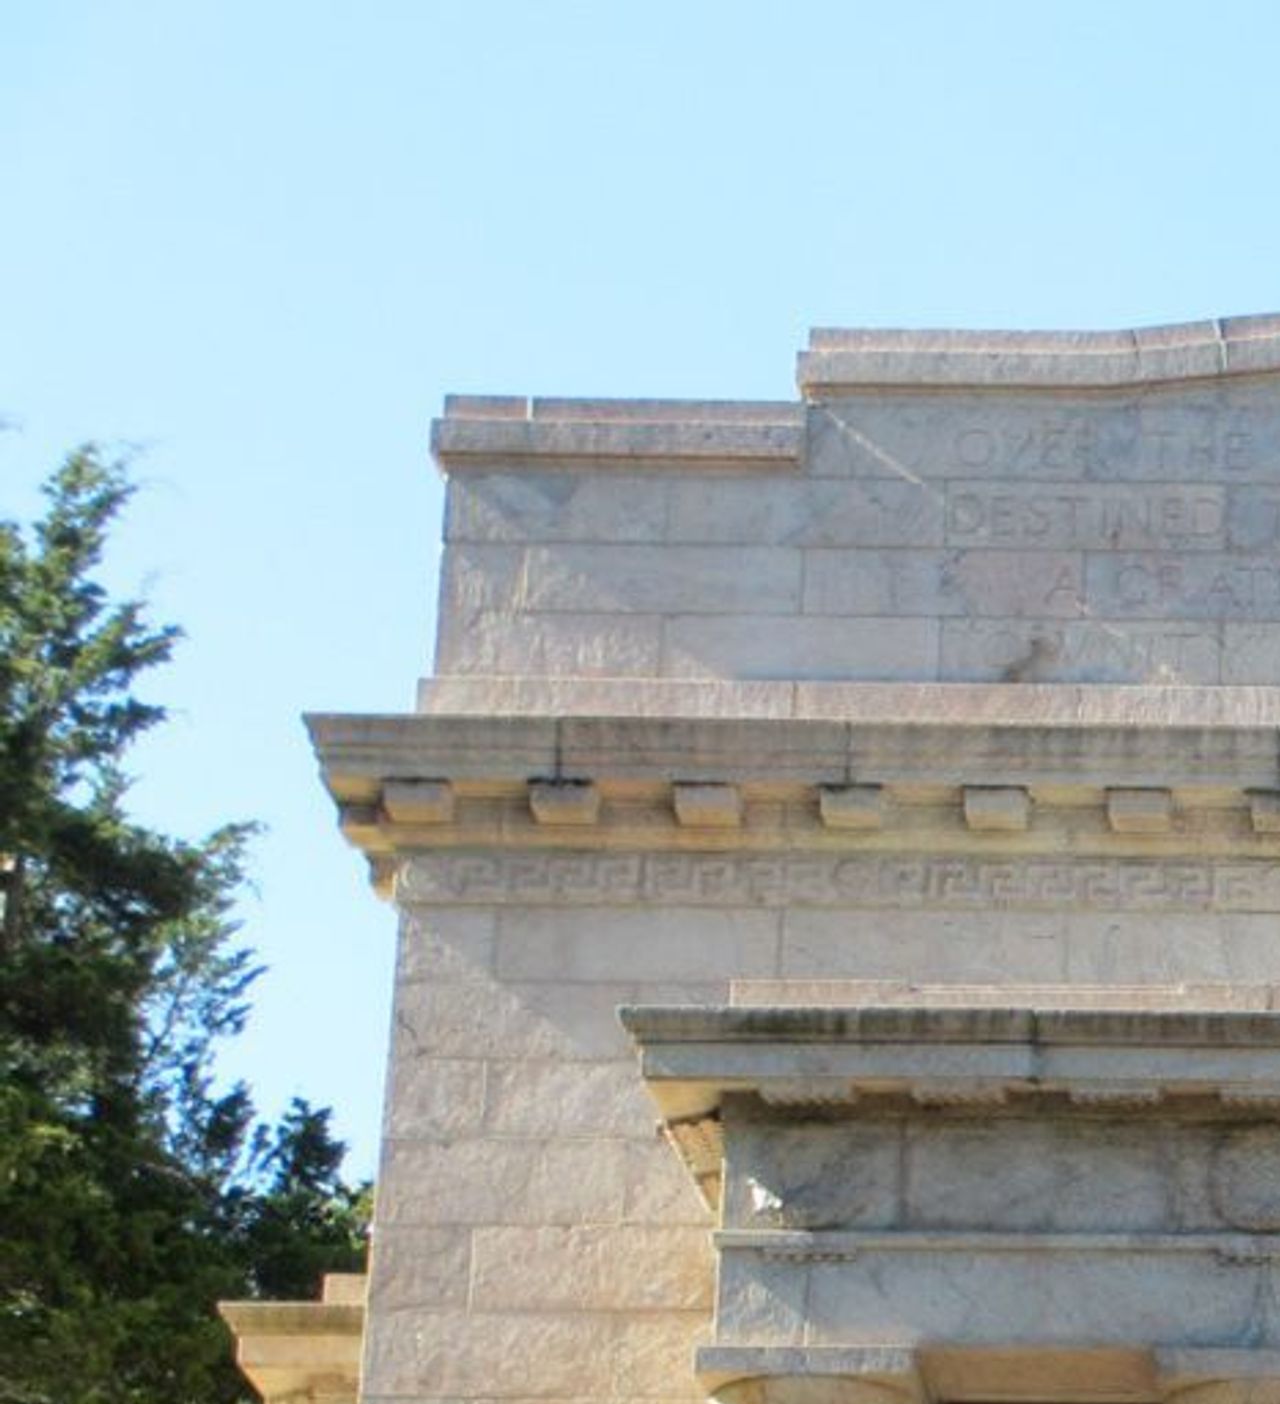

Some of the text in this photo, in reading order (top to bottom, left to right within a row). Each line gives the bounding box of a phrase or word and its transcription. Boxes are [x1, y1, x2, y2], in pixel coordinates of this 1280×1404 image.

[953, 428, 1112, 472] OVER
[1150, 430, 1254, 473] THE
[949, 494, 1224, 538] DESTINED
[1042, 564, 1078, 606] A
[944, 630, 1022, 673] O
